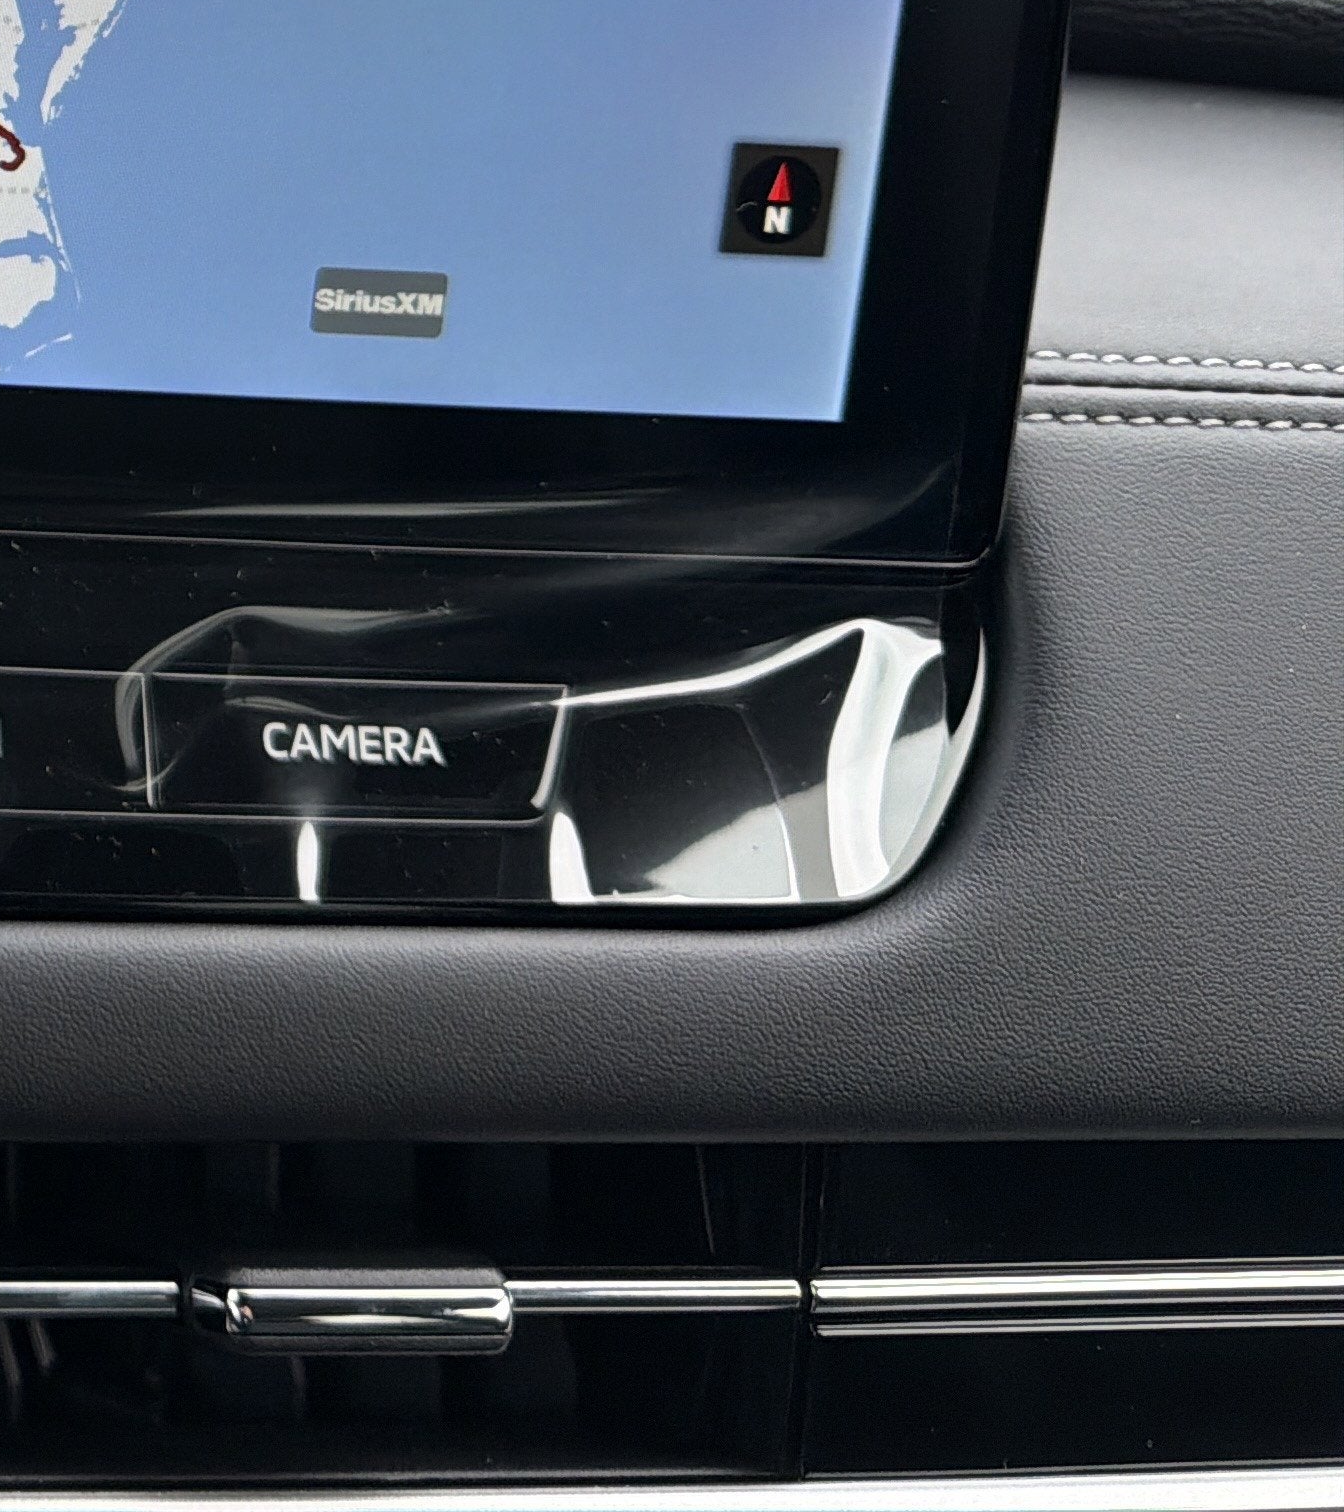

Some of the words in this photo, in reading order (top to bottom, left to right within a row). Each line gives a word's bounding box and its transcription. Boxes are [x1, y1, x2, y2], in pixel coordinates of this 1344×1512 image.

[763, 205, 790, 235] N
[314, 287, 444, 317] SiriusXM
[262, 721, 448, 768] CAMERA
